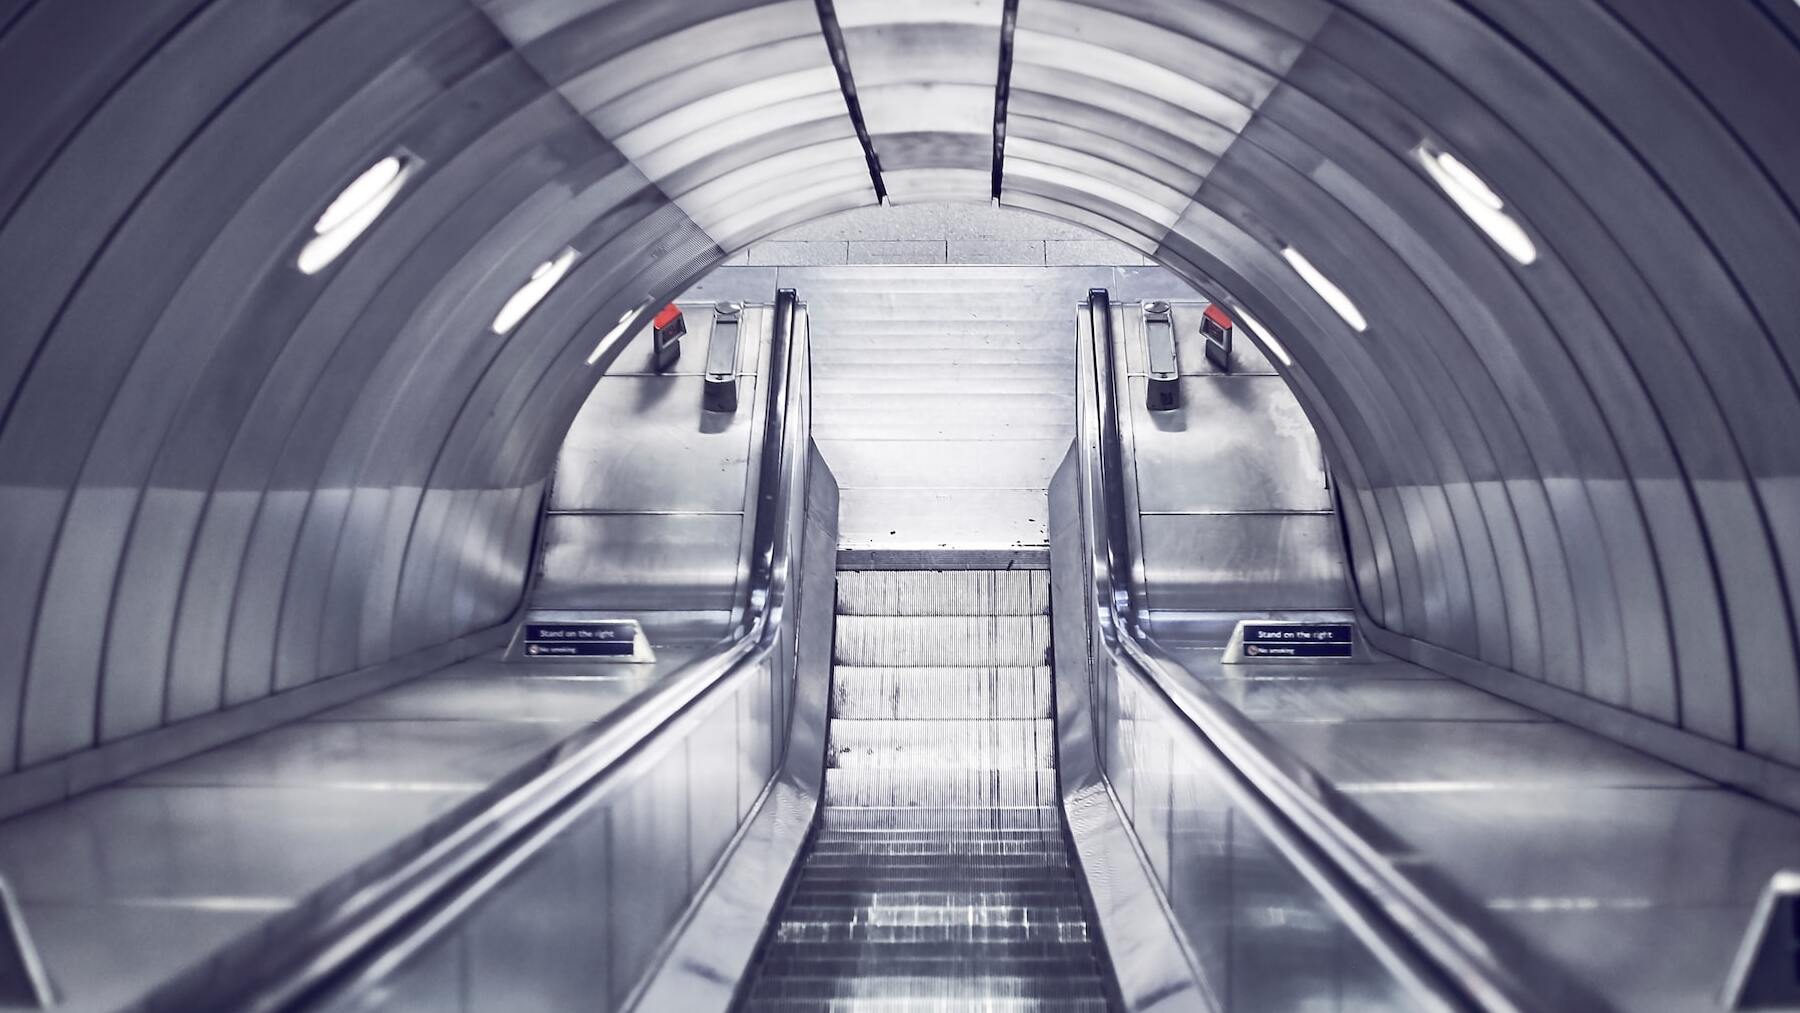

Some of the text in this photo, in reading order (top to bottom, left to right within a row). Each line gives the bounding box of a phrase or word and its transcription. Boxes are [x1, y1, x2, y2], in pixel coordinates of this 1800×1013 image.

[540, 630, 563, 638] Stand
[1258, 630, 1281, 638] Stand
[1313, 631, 1333, 640] right
